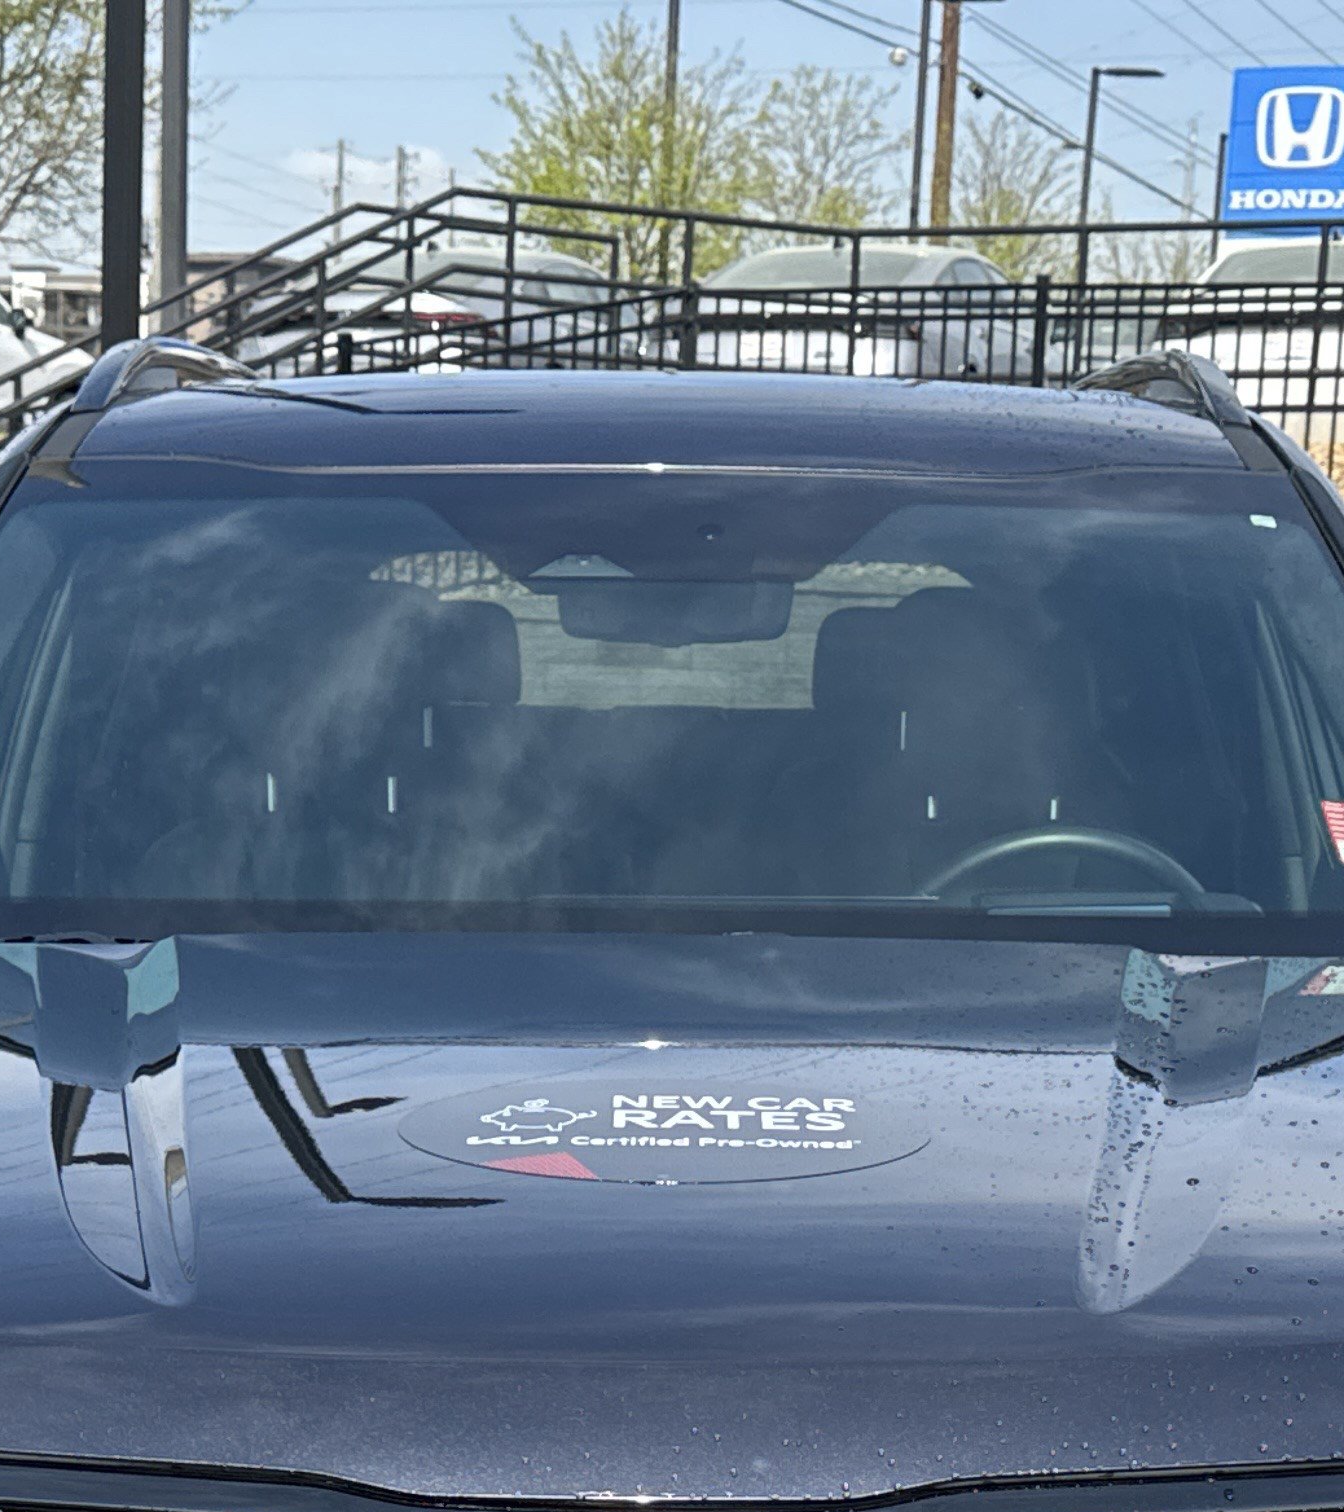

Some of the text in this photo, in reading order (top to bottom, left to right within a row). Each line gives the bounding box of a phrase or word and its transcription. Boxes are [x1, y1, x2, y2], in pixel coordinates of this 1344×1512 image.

[612, 1094, 856, 1112] NEW CAR
[612, 1109, 846, 1131] RATES
[570, 1135, 690, 1147] Certified
